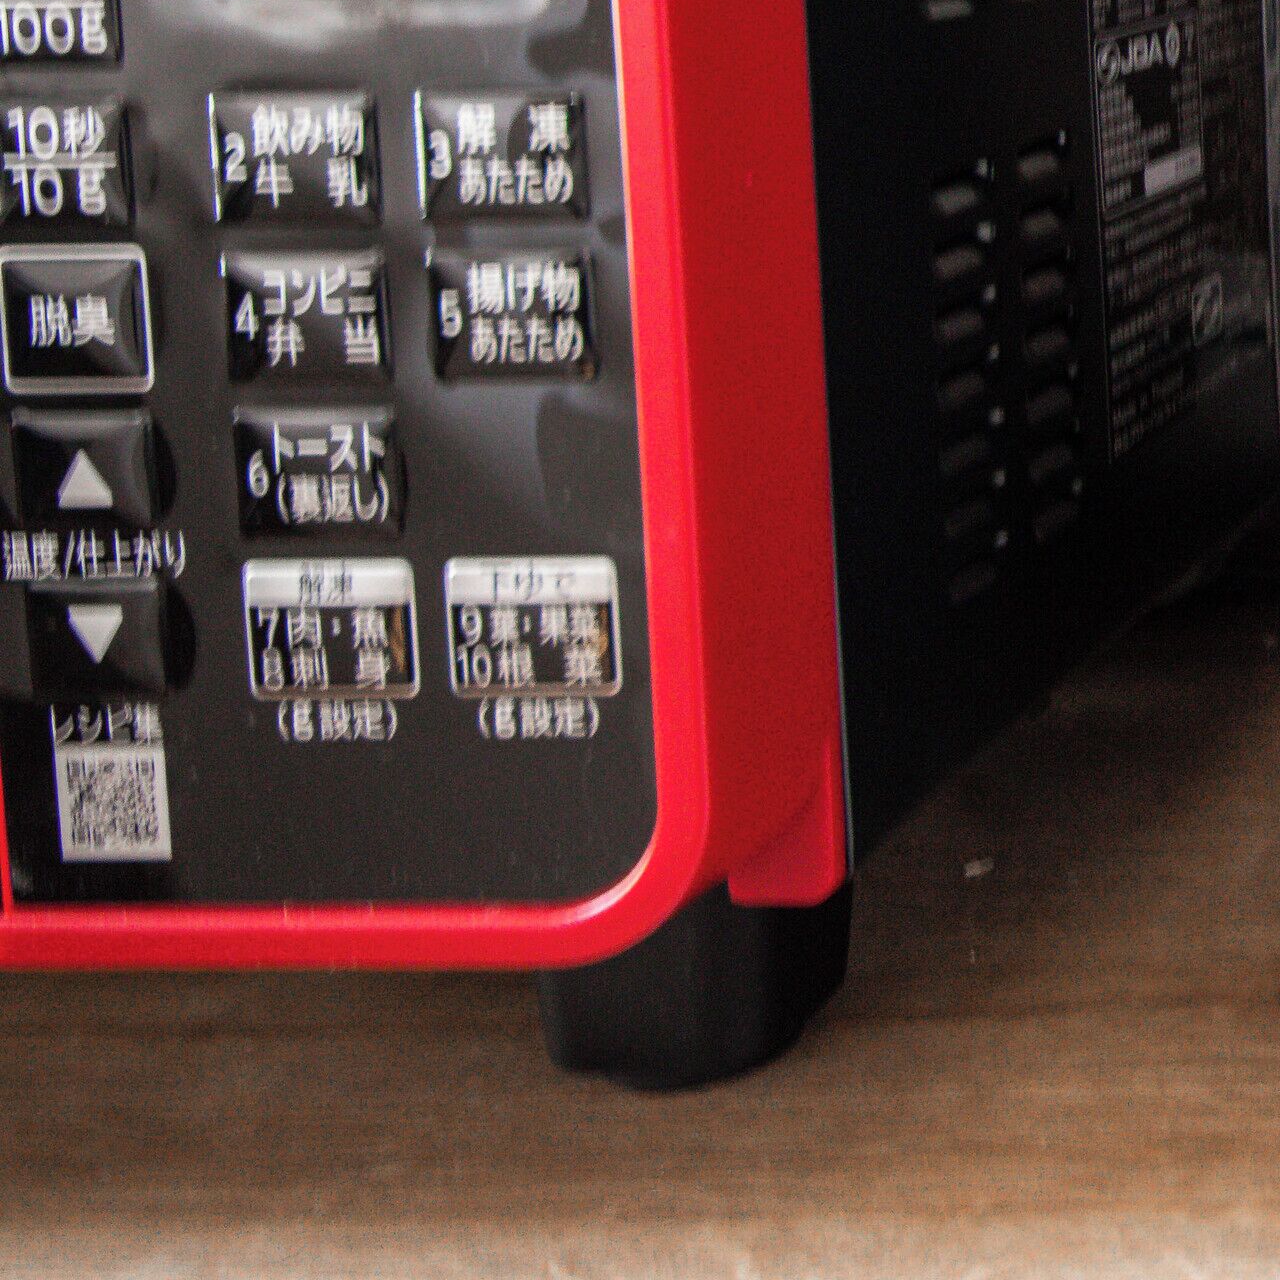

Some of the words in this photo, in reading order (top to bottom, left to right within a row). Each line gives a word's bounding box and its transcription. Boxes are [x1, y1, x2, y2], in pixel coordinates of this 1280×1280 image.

[8, 105, 107, 161] 10秒
[252, 102, 365, 156] 飲み物
[429, 129, 452, 180] 3
[225, 131, 248, 182] 2
[458, 153, 574, 206] あたため
[235, 291, 259, 341] 4
[262, 267, 377, 317] コンビニ
[439, 287, 464, 338] 5
[30, 294, 116, 348] 脱臭
[469, 312, 584, 365] あたため
[272, 420, 386, 473] トースト
[246, 448, 270, 498] 6
